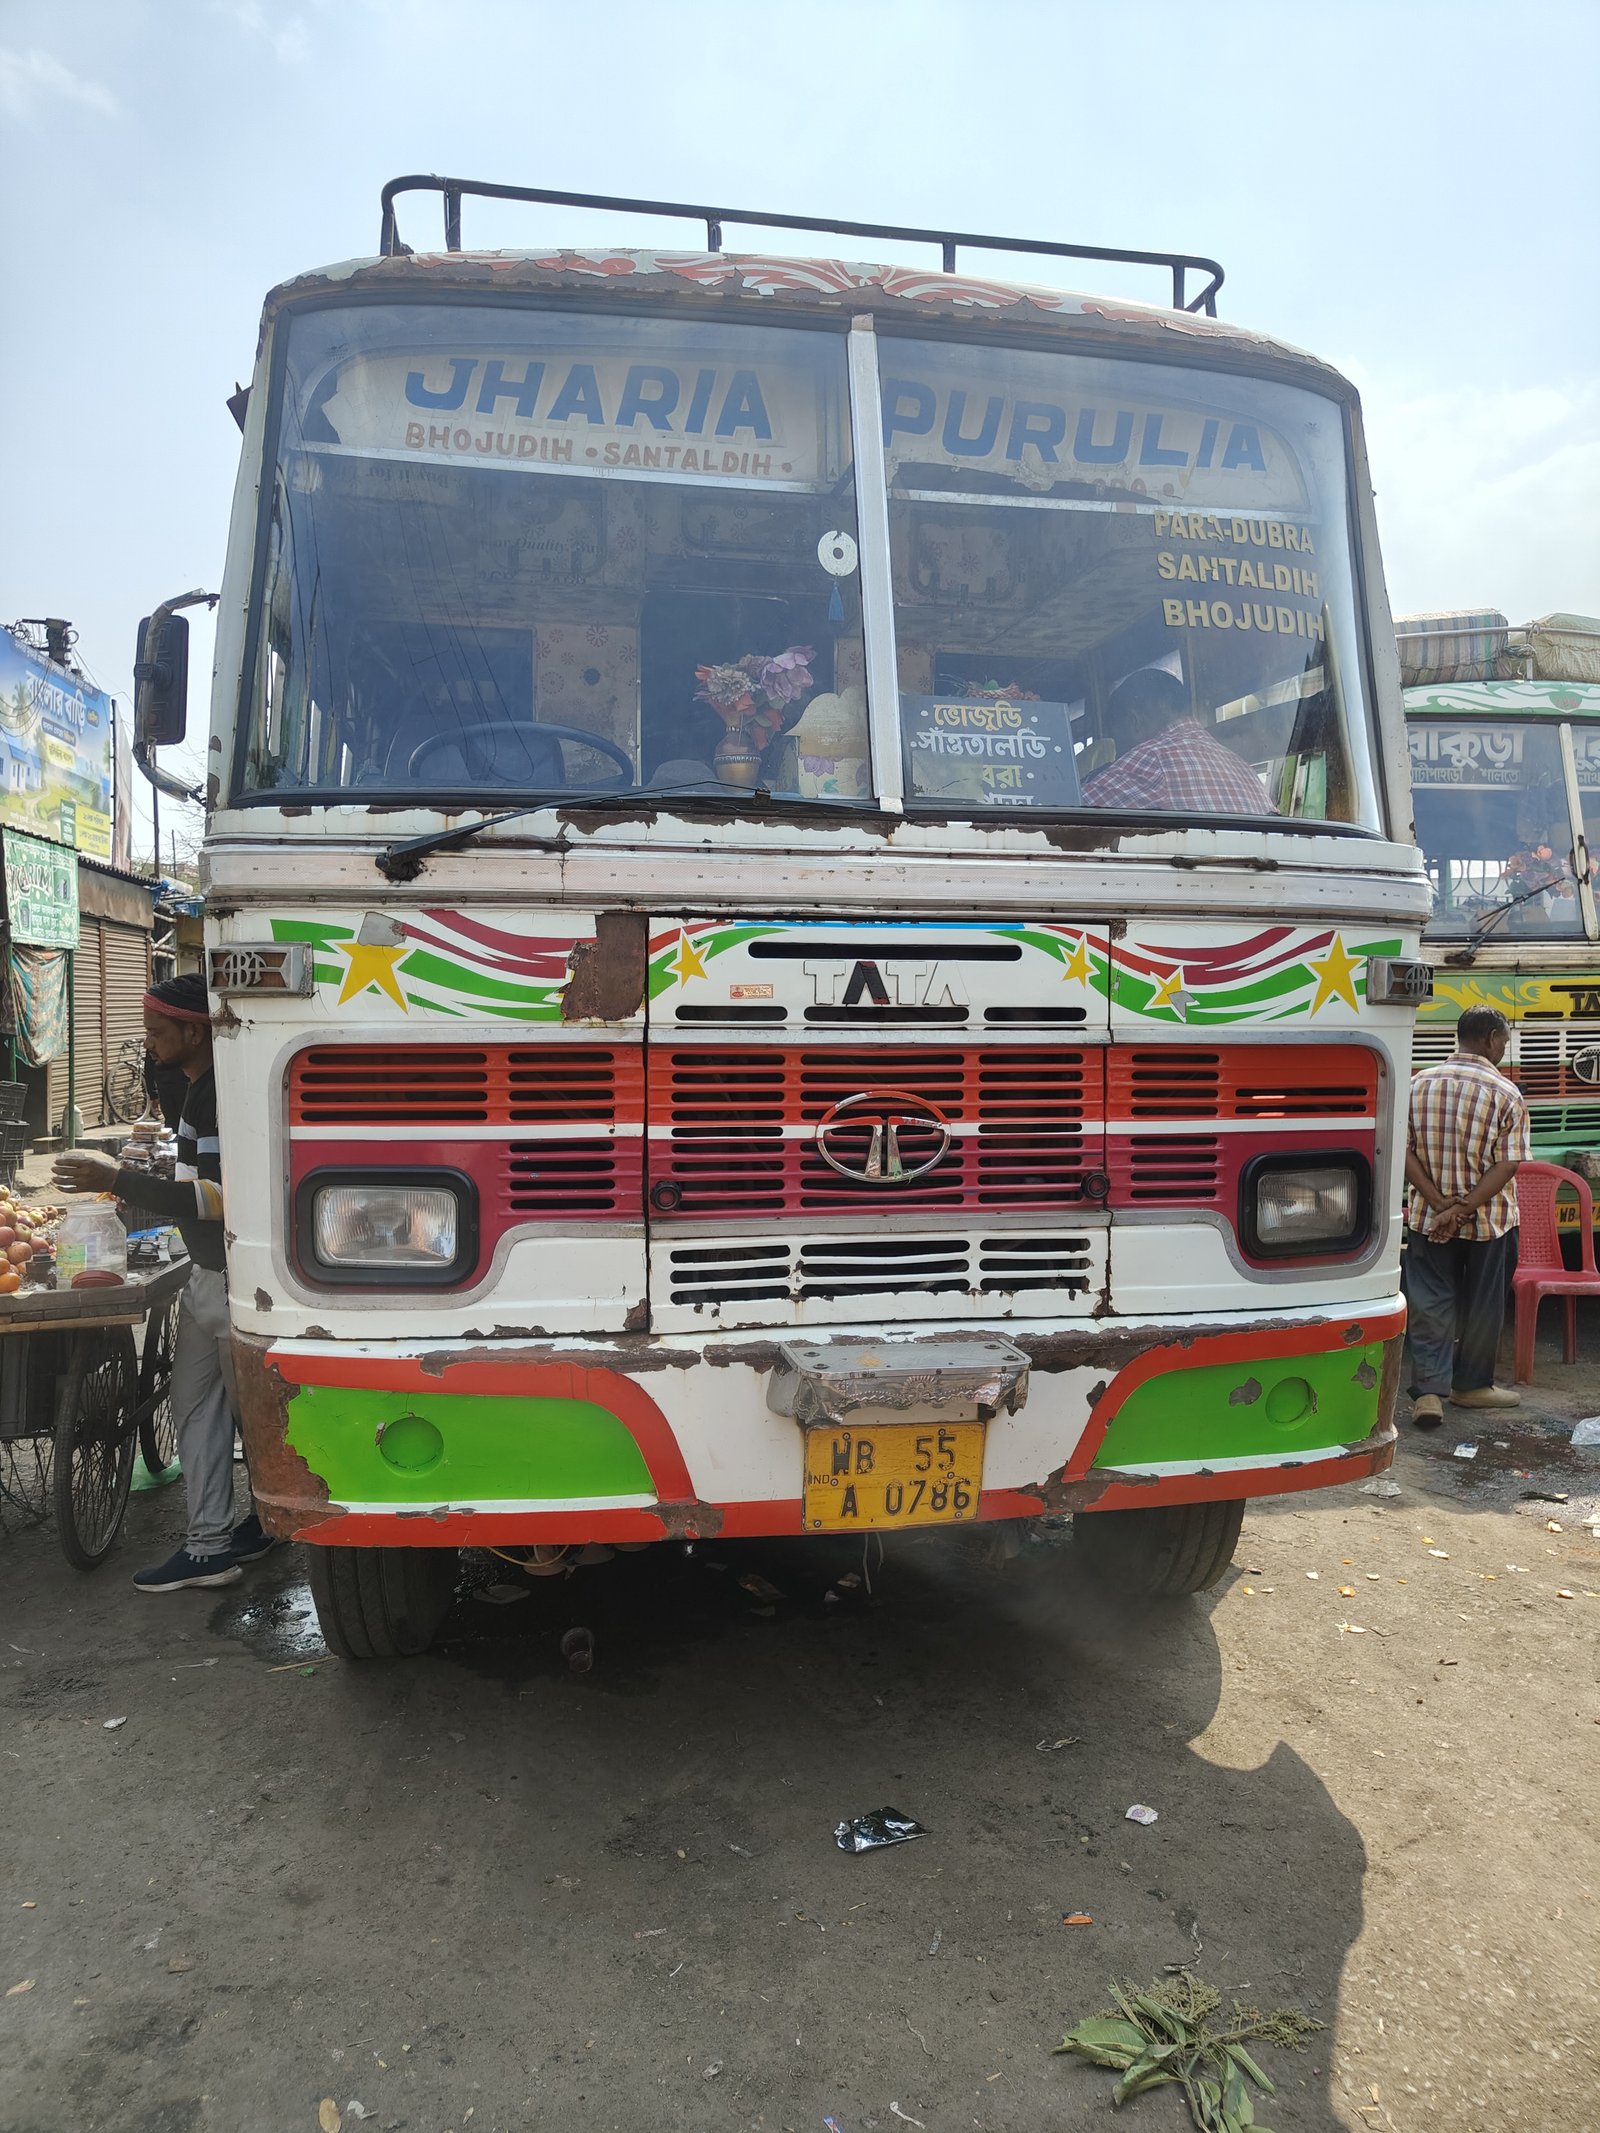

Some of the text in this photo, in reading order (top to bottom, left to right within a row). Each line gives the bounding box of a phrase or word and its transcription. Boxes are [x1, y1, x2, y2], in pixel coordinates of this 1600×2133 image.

[404, 356, 773, 441] JHARIA
[404, 421, 774, 475] BHOJUDIH SANTALDIH
[884, 378, 1267, 472] PURULIA
[1157, 551, 1319, 599] SANTALDIH
[1162, 598, 1326, 642] BHOJUDIH
[803, 960, 971, 1006] TATA
[831, 1434, 956, 1475] WB 55
[840, 1478, 971, 1518] A 0786
